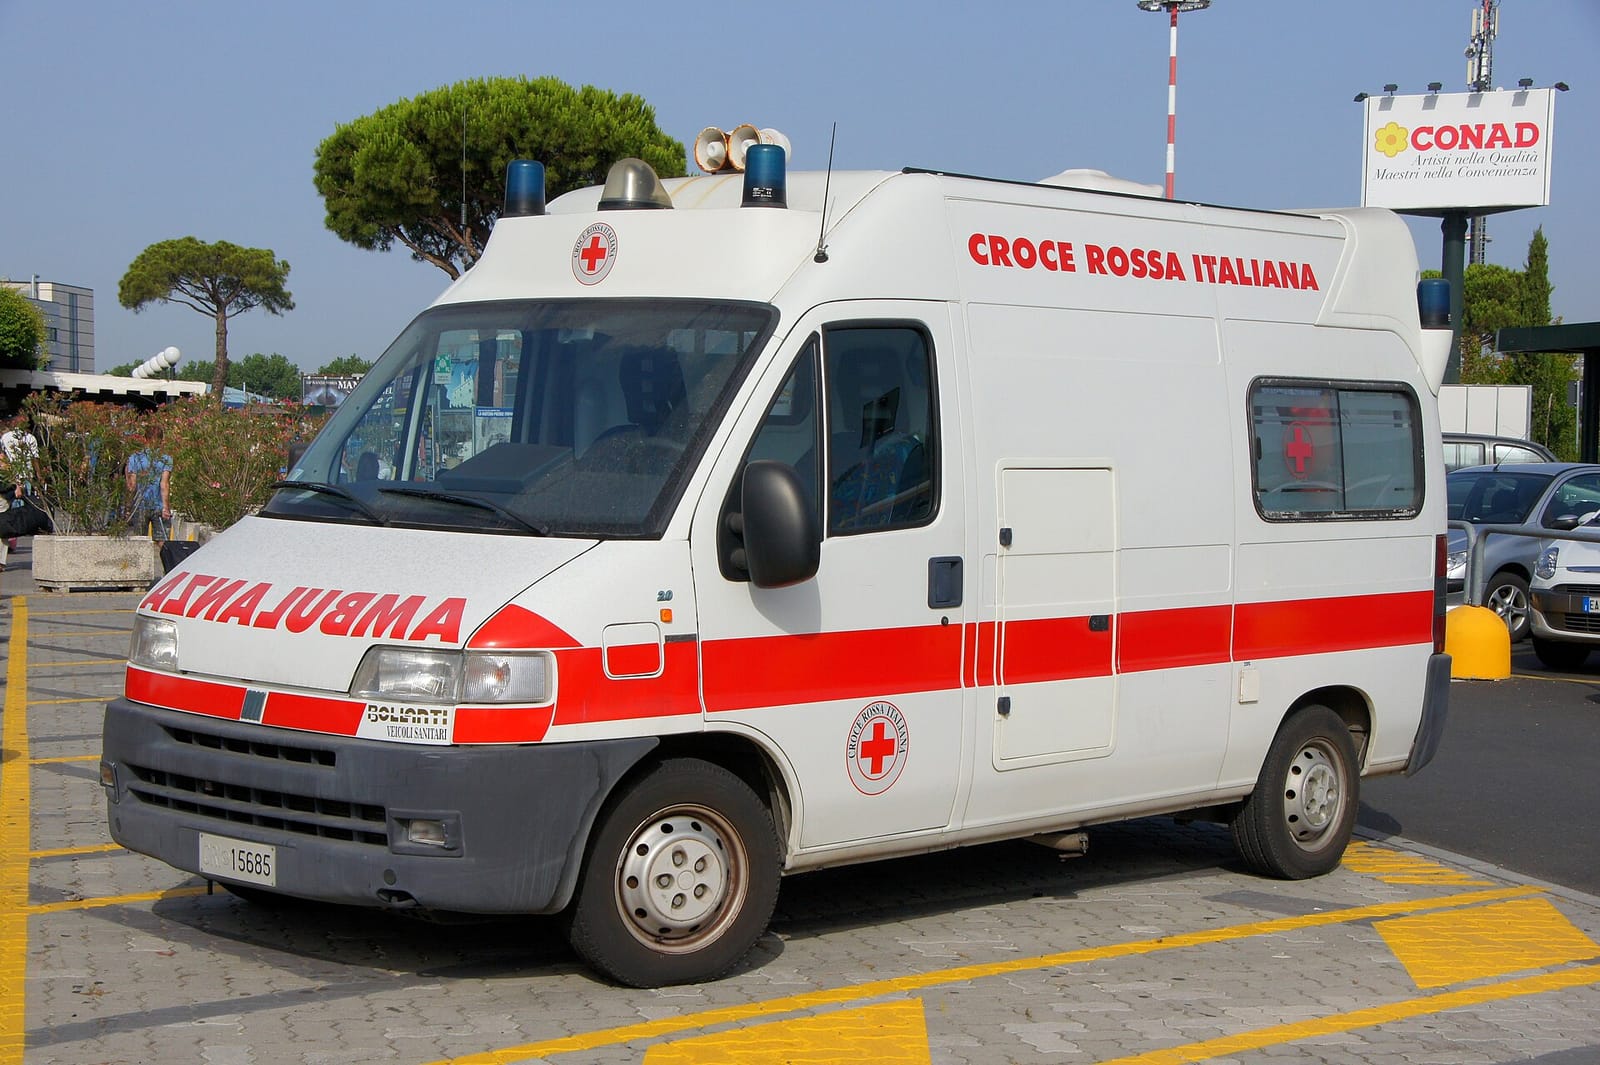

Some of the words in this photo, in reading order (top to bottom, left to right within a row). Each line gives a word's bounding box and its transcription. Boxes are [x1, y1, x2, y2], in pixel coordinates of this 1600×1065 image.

[1411, 122, 1540, 151] CONAD
[1412, 153, 1452, 166] Artisti
[1454, 152, 1485, 165] nella
[1489, 150, 1539, 166] Qualità
[1375, 167, 1421, 180] Maestri
[1423, 167, 1453, 180] nella
[1457, 164, 1537, 178] Convenienza
[967, 233, 1076, 272] CROCE
[1085, 243, 1186, 282] ROSSA
[1192, 253, 1320, 291] ITALIANA
[367, 704, 448, 726] BOLLANTI
[386, 725, 413, 739] VEICOLI
[414, 726, 447, 741] SANITARI
[848, 720, 864, 759] CROCE
[861, 703, 885, 723] ROSSA
[886, 705, 908, 754] ITALIANA
[231, 848, 271, 877] 15685
